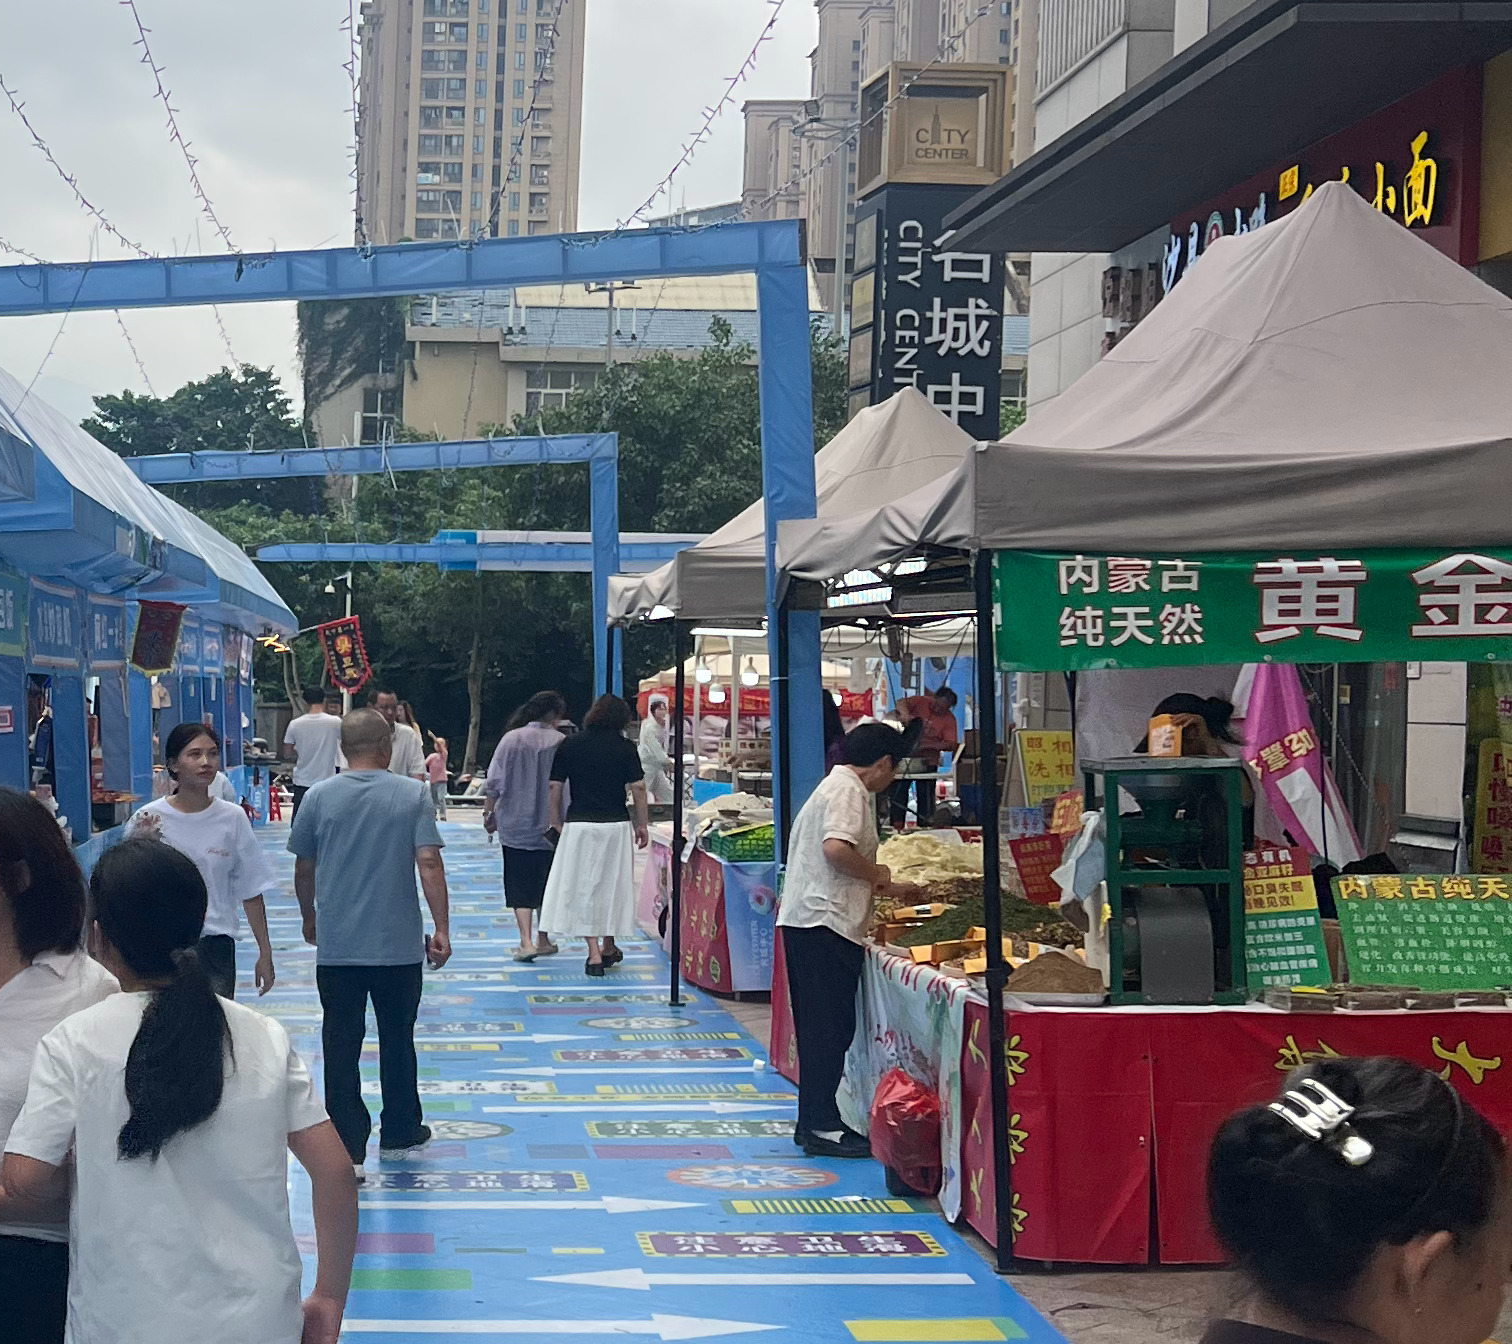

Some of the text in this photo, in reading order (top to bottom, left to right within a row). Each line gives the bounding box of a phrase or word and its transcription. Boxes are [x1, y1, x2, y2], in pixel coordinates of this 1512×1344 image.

[915, 147, 969, 160] CENTER
[893, 220, 923, 394] CITY CENT
[1058, 555, 1200, 594] 内蒙古
[1252, 554, 1512, 644] 黄金
[1059, 604, 1205, 648] 纯天然
[1339, 876, 1509, 900] 内蒙古纯天
